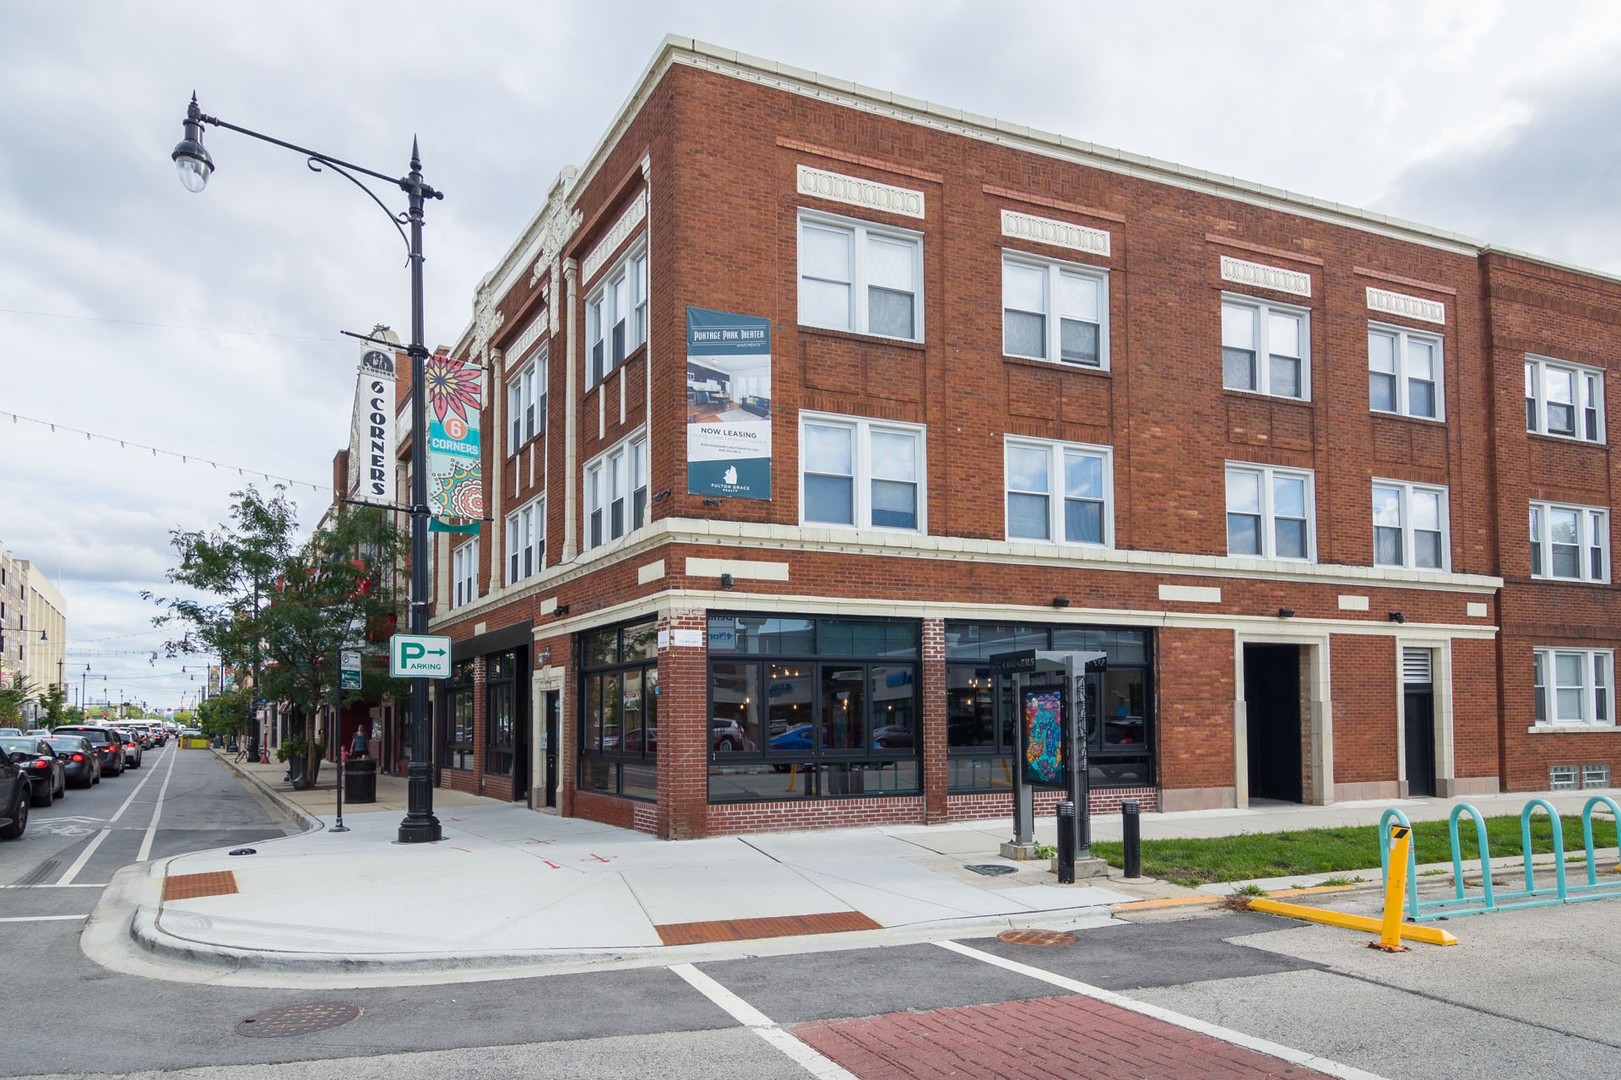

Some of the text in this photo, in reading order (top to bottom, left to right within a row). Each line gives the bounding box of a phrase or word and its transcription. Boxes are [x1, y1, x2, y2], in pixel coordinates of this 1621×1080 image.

[694, 329, 765, 341] PORTAGE PARK THEATER
[451, 420, 462, 437] 6
[701, 427, 721, 435] NOW
[723, 430, 757, 439] LEASING
[370, 381, 387, 496] 6 CORNERS
[432, 438, 479, 455] CORNERS
